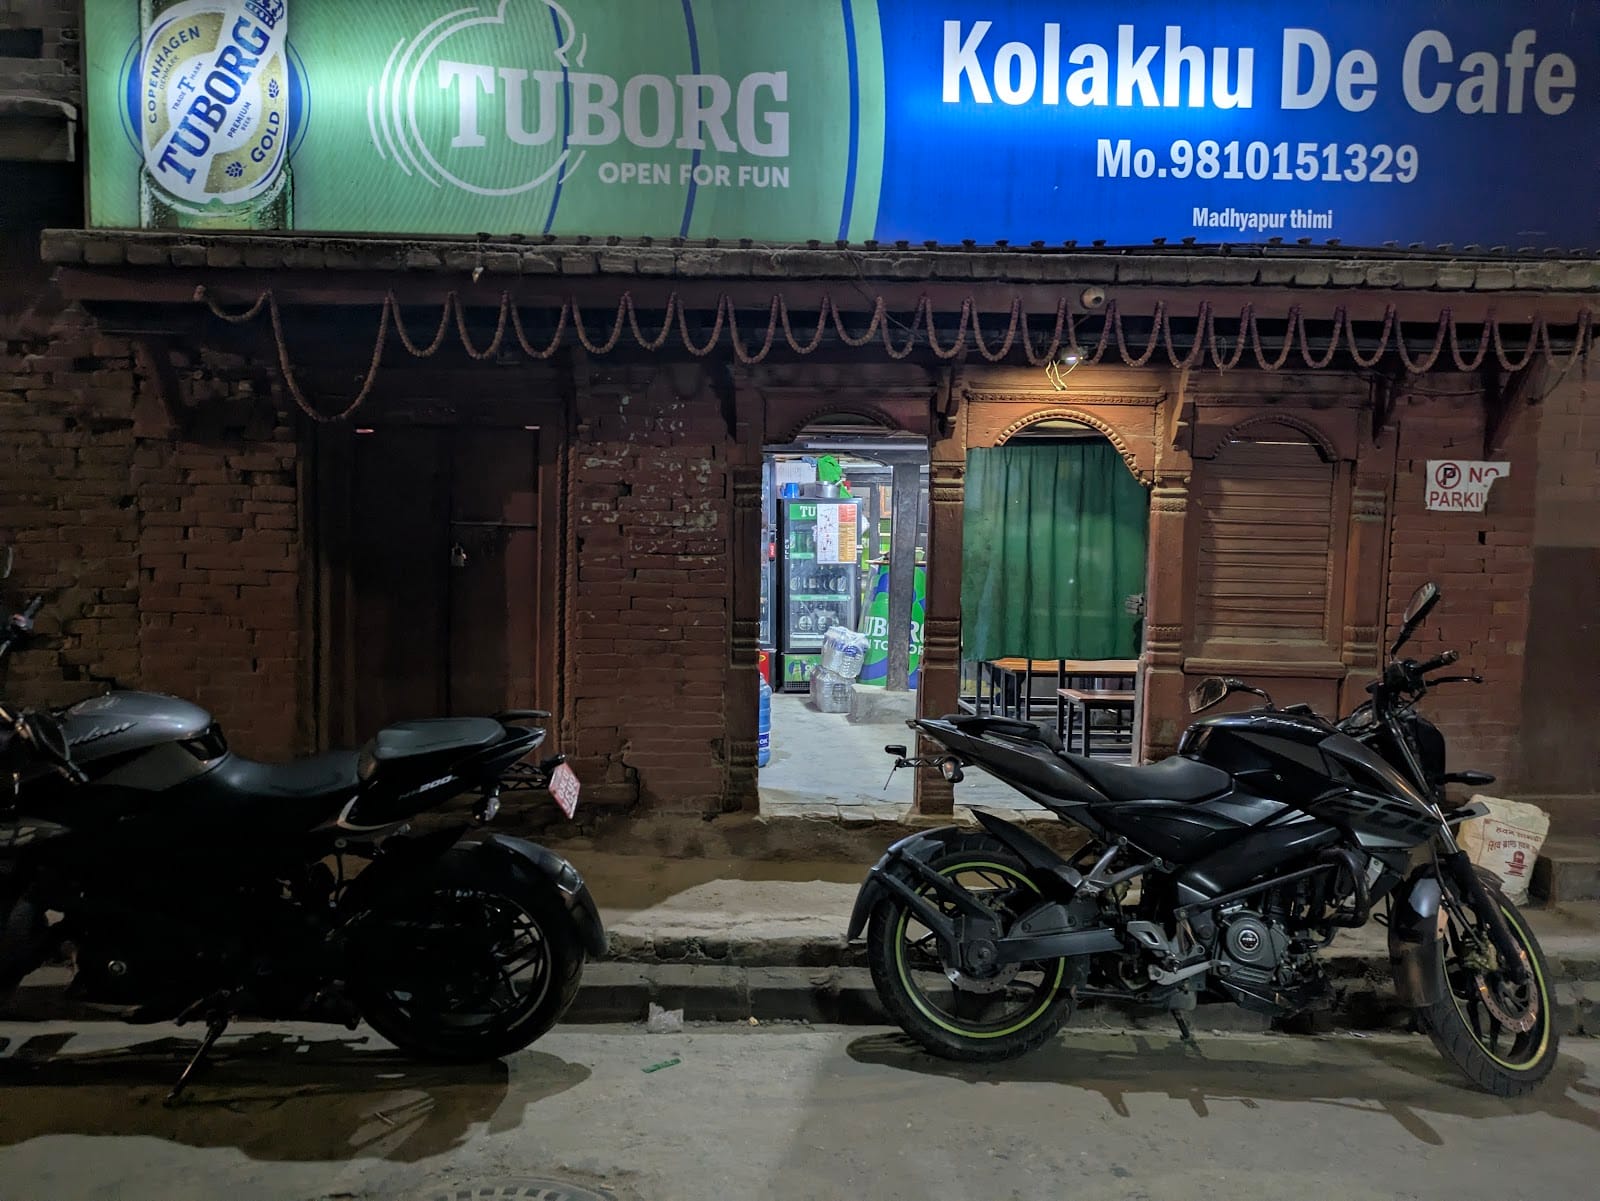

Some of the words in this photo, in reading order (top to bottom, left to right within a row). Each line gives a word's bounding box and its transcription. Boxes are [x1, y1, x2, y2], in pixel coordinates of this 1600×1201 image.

[148, 25, 200, 123] COPENHAGEN
[160, 55, 179, 90] DENMARK
[942, 20, 1254, 109] Kolakhu
[1280, 28, 1378, 113] De
[1402, 28, 1577, 116] Cafe
[157, 16, 270, 184] TUBORG
[227, 101, 252, 138] PREMIUM
[438, 59, 790, 157] TUBORG
[250, 111, 280, 163] GOLD
[598, 162, 671, 185] OPEN
[680, 163, 731, 187] FOR
[738, 165, 790, 188] FUN
[1096, 138, 1418, 183] Mo.9810151329
[1193, 207, 1287, 232] Madhyapur
[1290, 208, 1333, 229] thimi
[1429, 491, 1483, 507] PARKI
